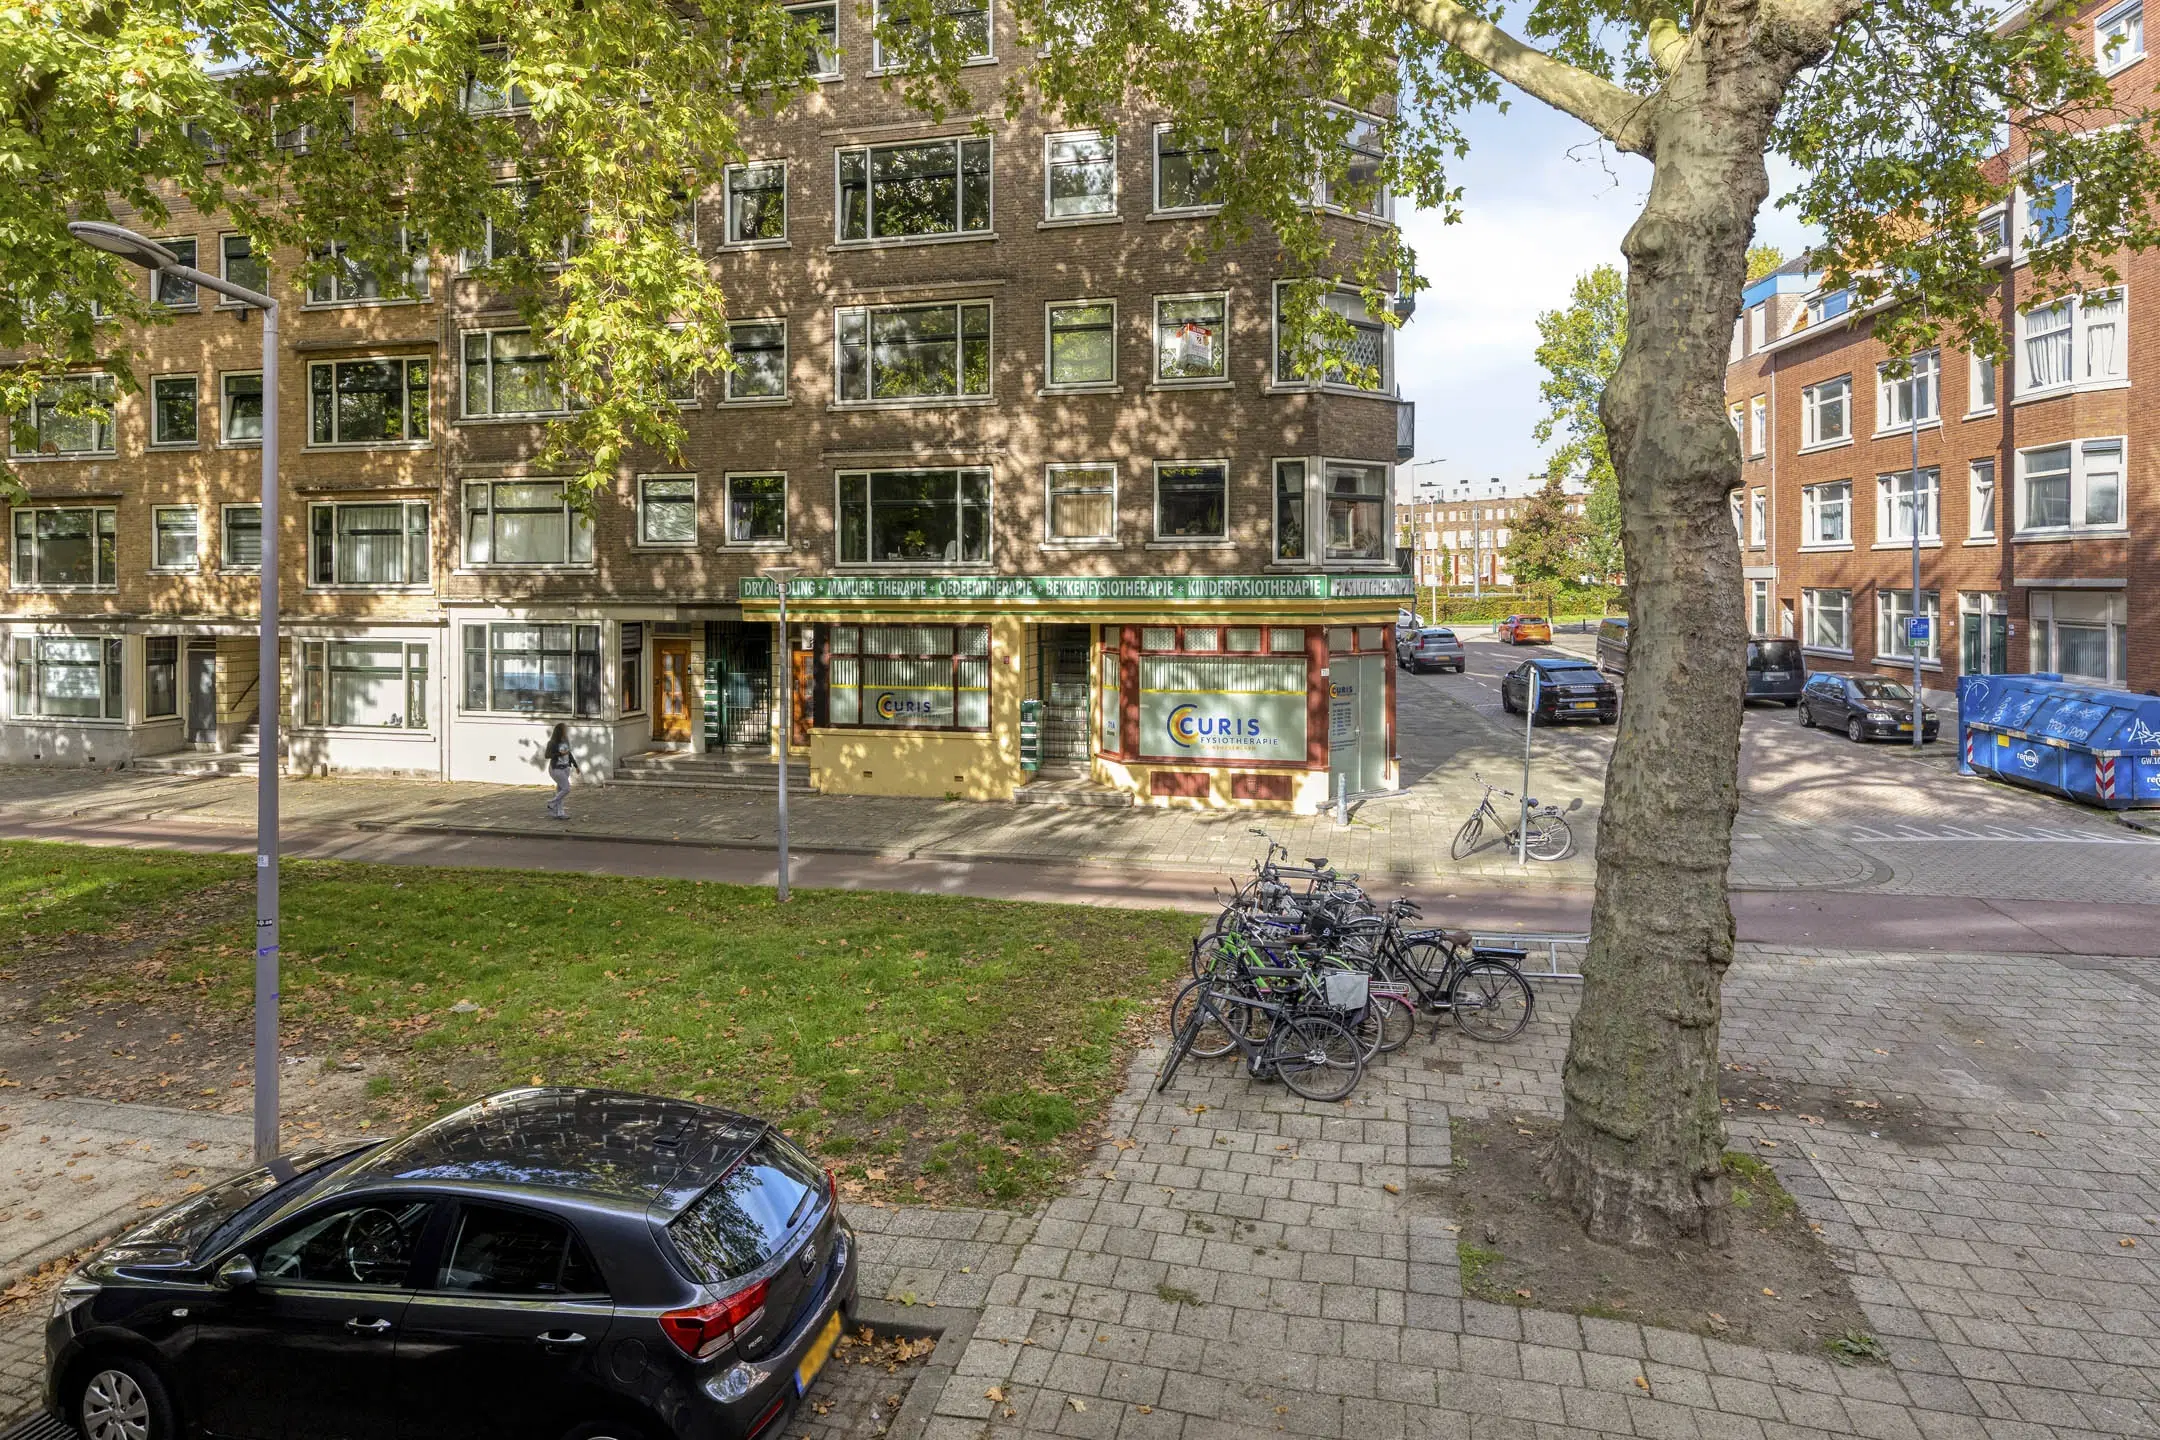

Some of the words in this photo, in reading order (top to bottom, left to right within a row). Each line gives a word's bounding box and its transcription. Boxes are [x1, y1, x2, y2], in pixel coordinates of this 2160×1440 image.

[744, 581, 764, 596] DRY
[766, 580, 816, 596] NEDLING
[827, 580, 875, 596] MANUELE
[877, 580, 927, 596] THERAPIE
[938, 580, 1033, 596] OEDEEMTHERAPIE
[1045, 580, 1174, 596] BEKKENFYSIOTHERAPIE
[1187, 579, 1321, 596] KINDERFYSIOTHERAPIE
[884, 701, 931, 712] CURIS
[1180, 717, 1260, 736] CURIS
[1200, 736, 1279, 746] FYSIOTHERAPIE
